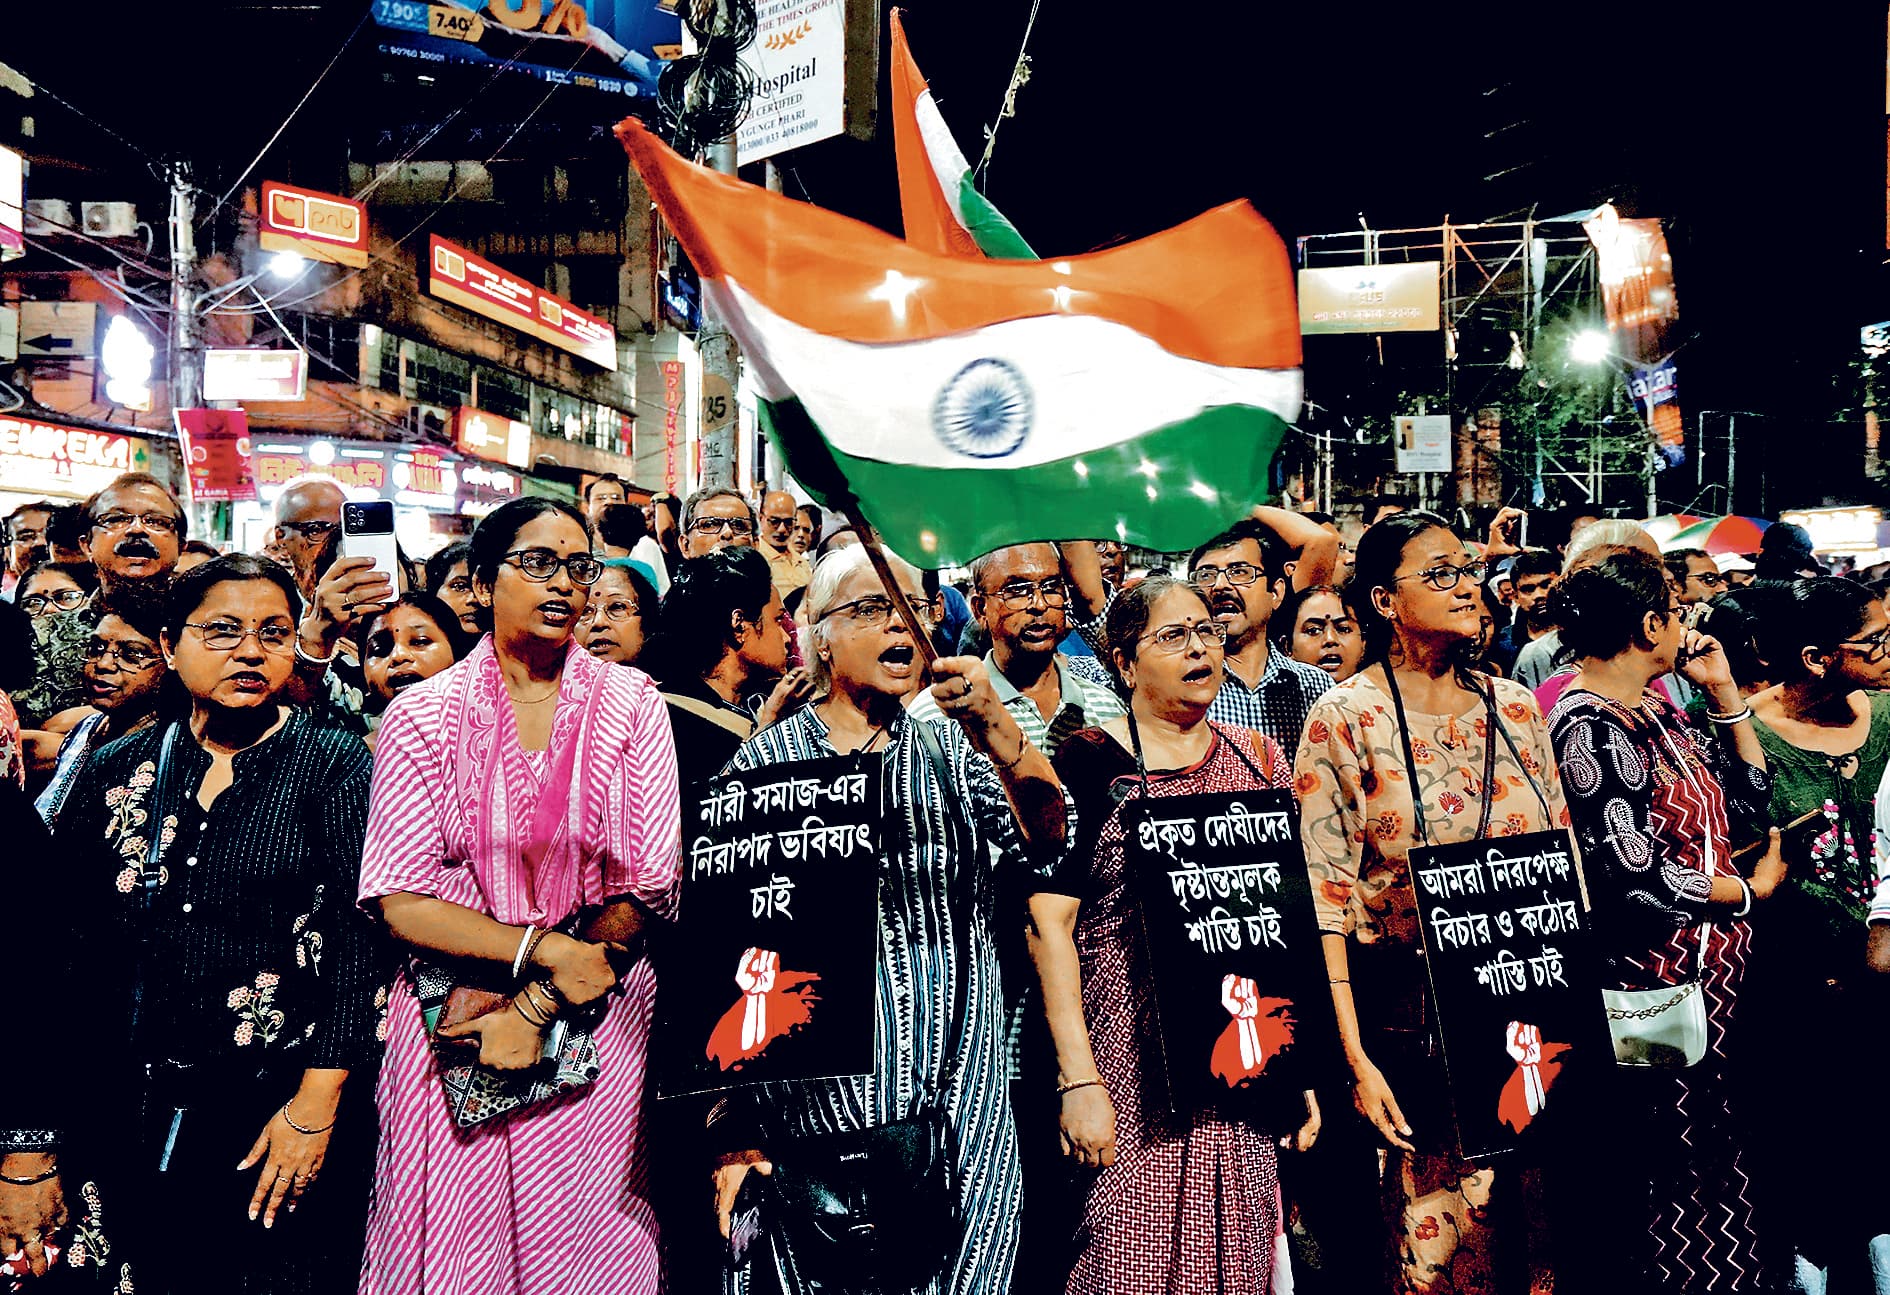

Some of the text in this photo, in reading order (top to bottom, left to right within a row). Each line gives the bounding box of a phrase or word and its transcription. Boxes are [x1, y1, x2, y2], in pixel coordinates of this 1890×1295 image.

[758, 20, 774, 33] THE
[777, 10, 803, 26] TIMES
[756, 93, 803, 118] CERTIFIED
[311, 209, 353, 229] pnb
[699, 773, 869, 827] নারী সমাজ-এর
[689, 815, 874, 882] নিরাপদ ভবিষ্যৎ
[1138, 801, 1293, 861] প্রকৃত দোষীদের
[749, 872, 796, 921] চাই
[1166, 857, 1282, 913] দৃষ্টান্তমূলক
[1417, 848, 1571, 899] আমরা নিরপেক্ষ
[1183, 902, 1288, 954] শাস্তি চাই
[1429, 889, 1580, 952] বিচার ও কঠোর
[1473, 943, 1570, 996] শাস্তি চাই
